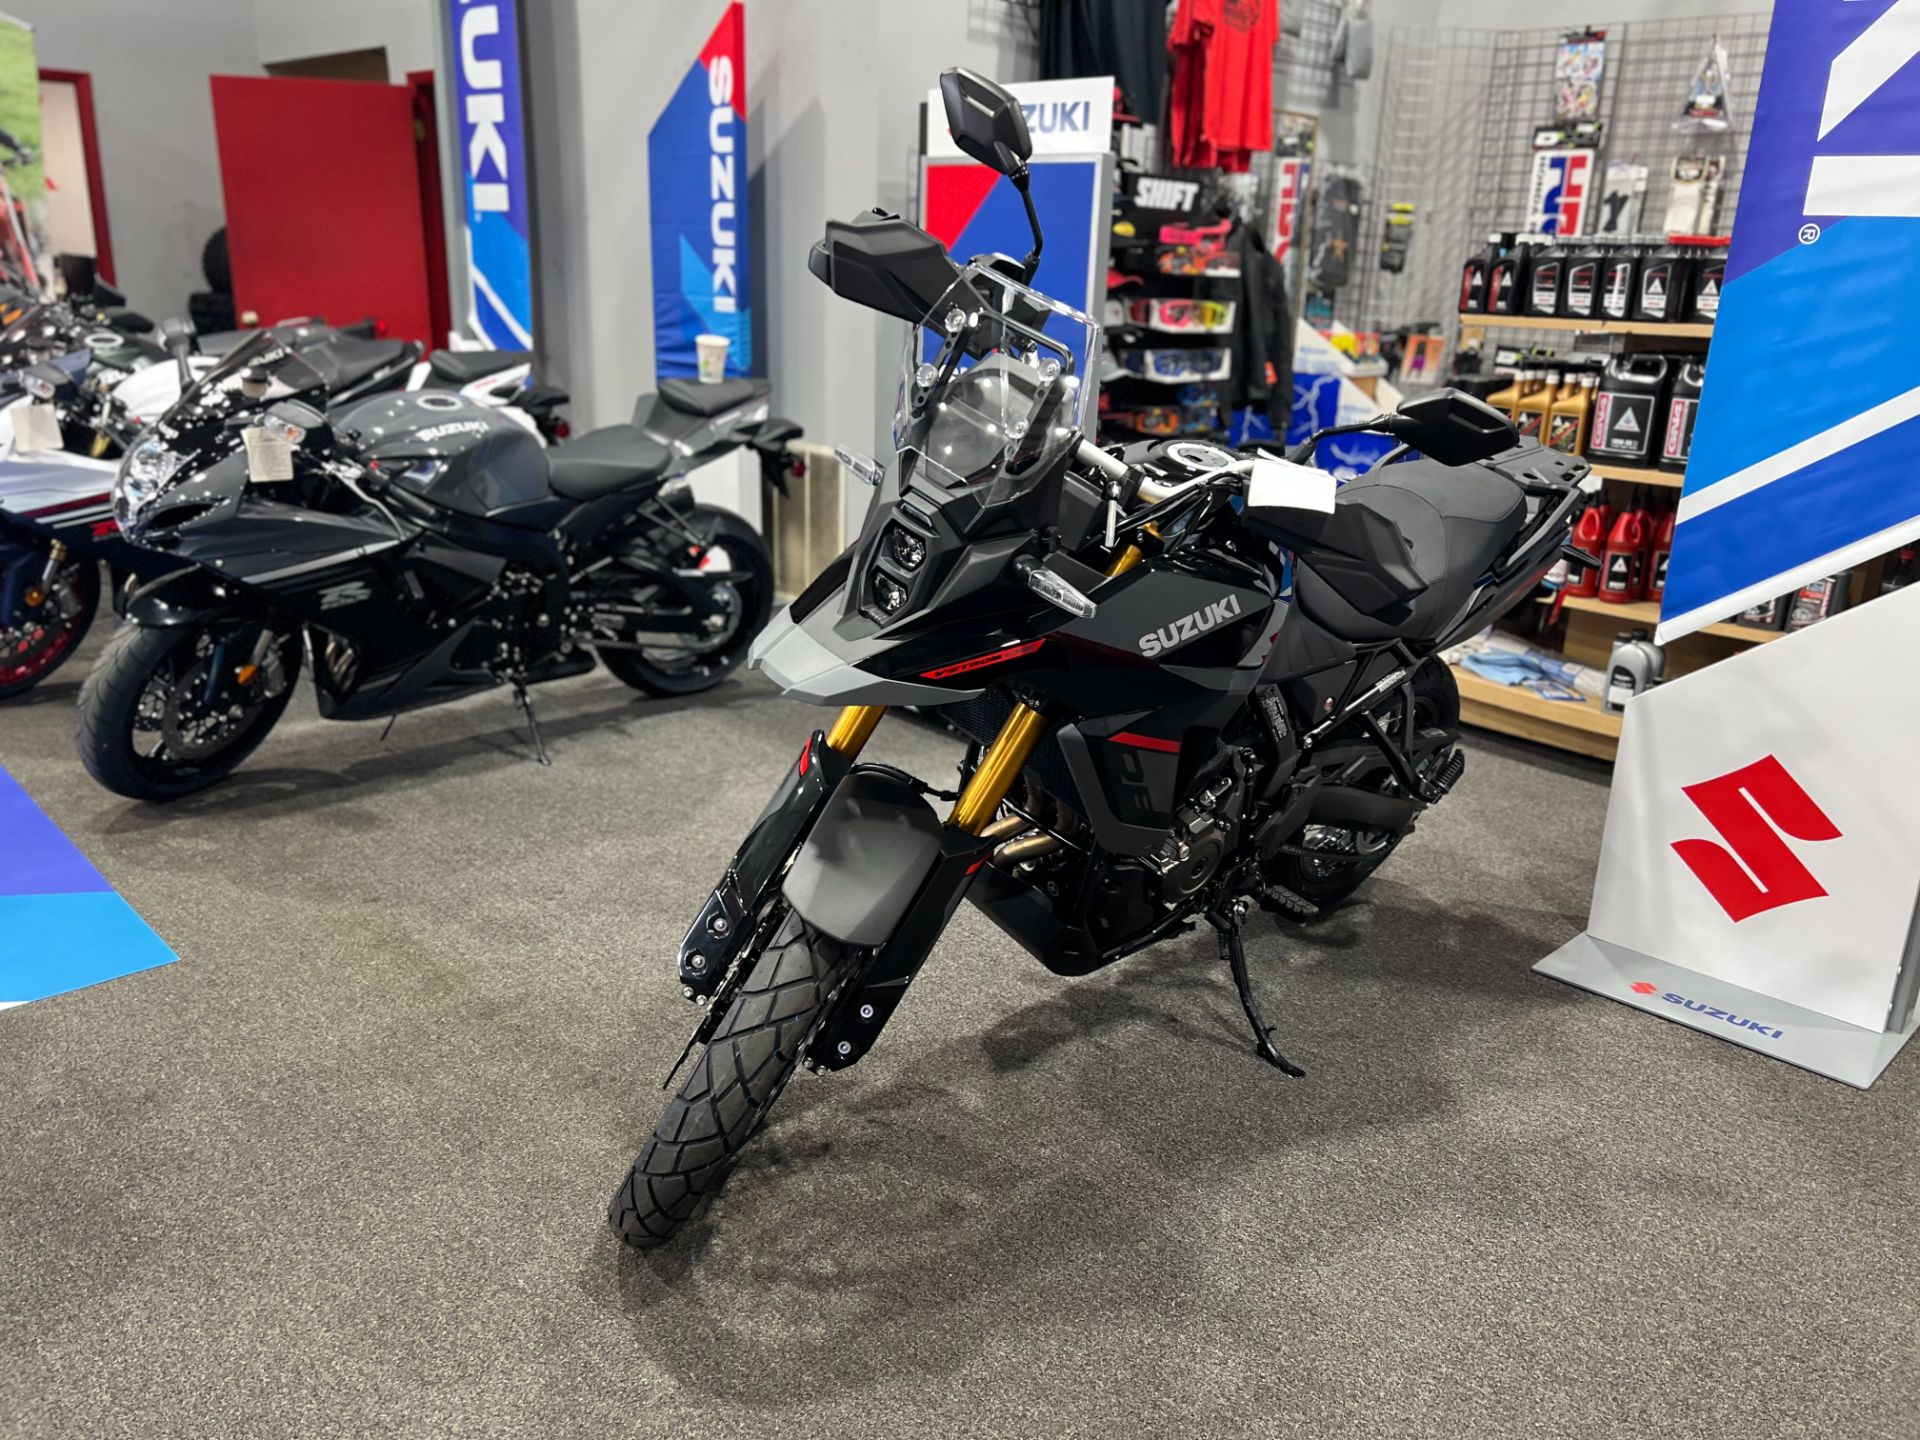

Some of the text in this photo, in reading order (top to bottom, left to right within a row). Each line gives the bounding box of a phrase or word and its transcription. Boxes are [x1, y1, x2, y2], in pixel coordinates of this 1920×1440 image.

[459, 0, 510, 212] UKI
[1021, 101, 1090, 133] ZUKI
[709, 55, 736, 313] SUZUKI
[1134, 177, 1199, 212] SHIFT
[1667, 402, 1683, 454] GN4
[1138, 594, 1241, 657] SUZUKI
[1662, 993, 1784, 1039] SUZUKI
